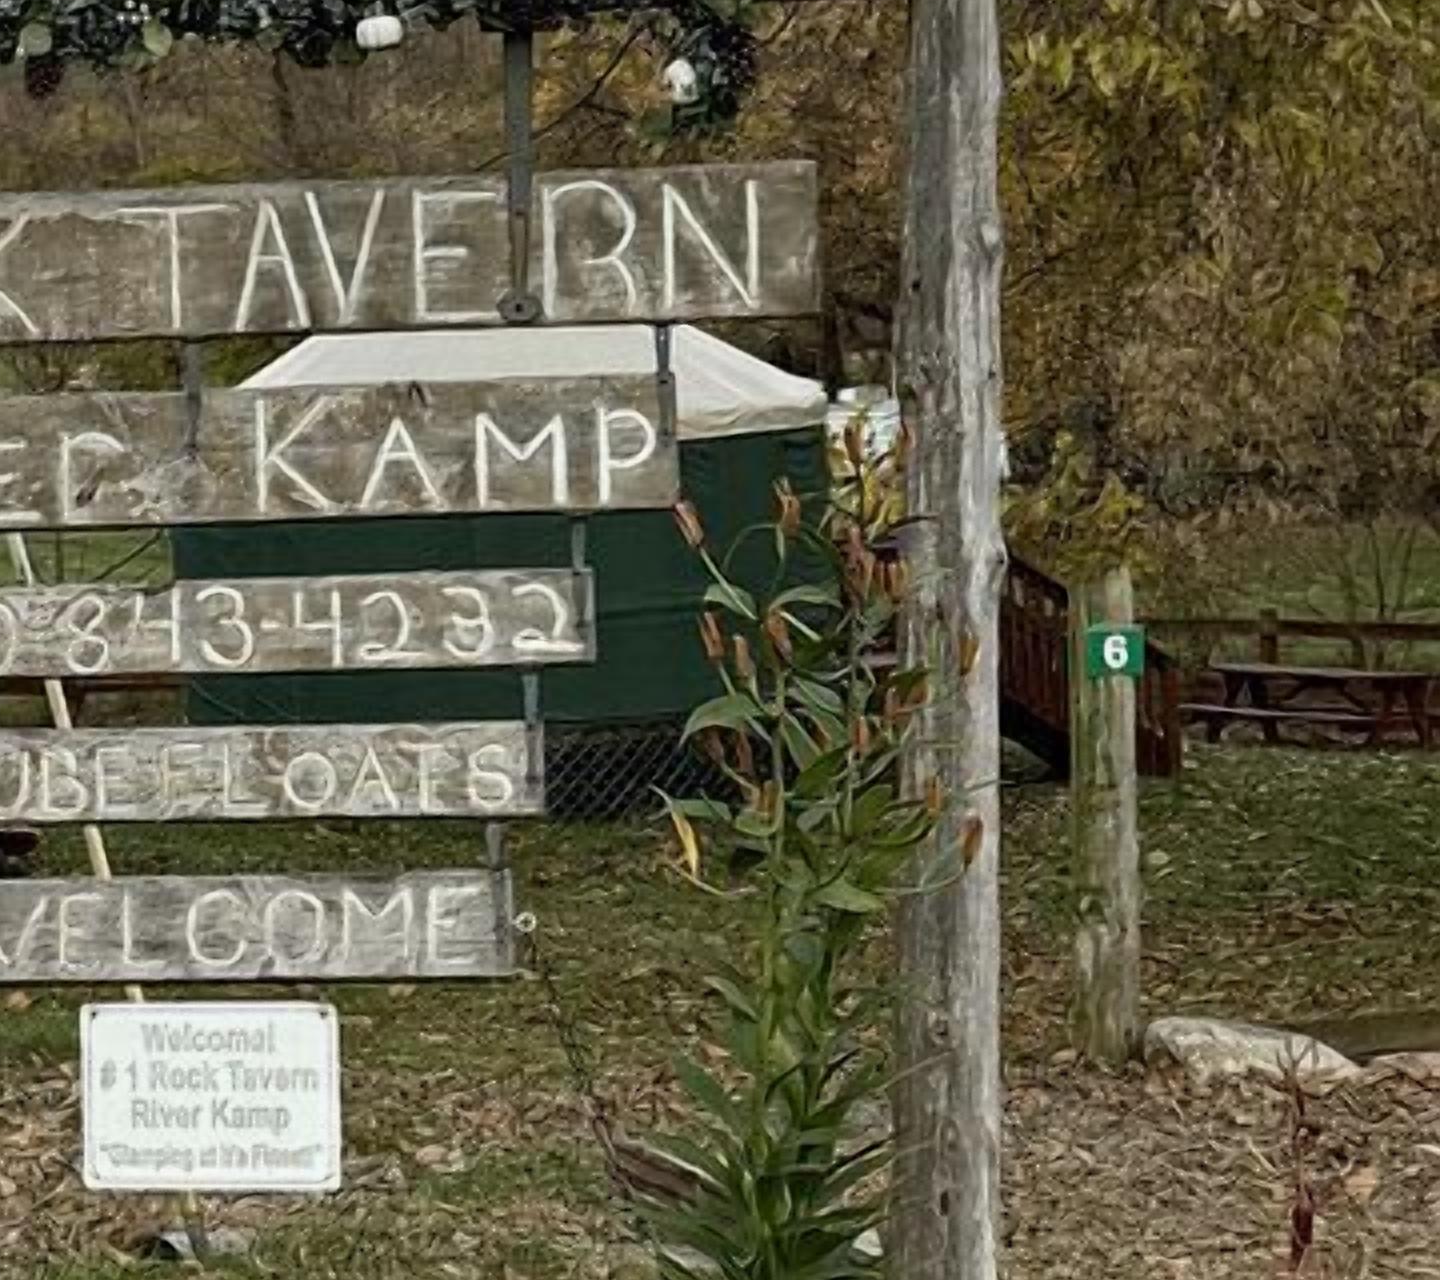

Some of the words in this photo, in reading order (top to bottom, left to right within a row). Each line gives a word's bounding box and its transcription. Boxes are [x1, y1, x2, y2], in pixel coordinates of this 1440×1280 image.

[114, 178, 763, 332] TAVERN
[252, 395, 659, 514] KAMP
[1103, 634, 1129, 669] 6
[159, 740, 512, 815] FLOATS
[148, 1060, 220, 1091] Rock
[224, 1060, 320, 1091] Tavern
[131, 1099, 203, 1129] River
[211, 1099, 293, 1135] Kamp
